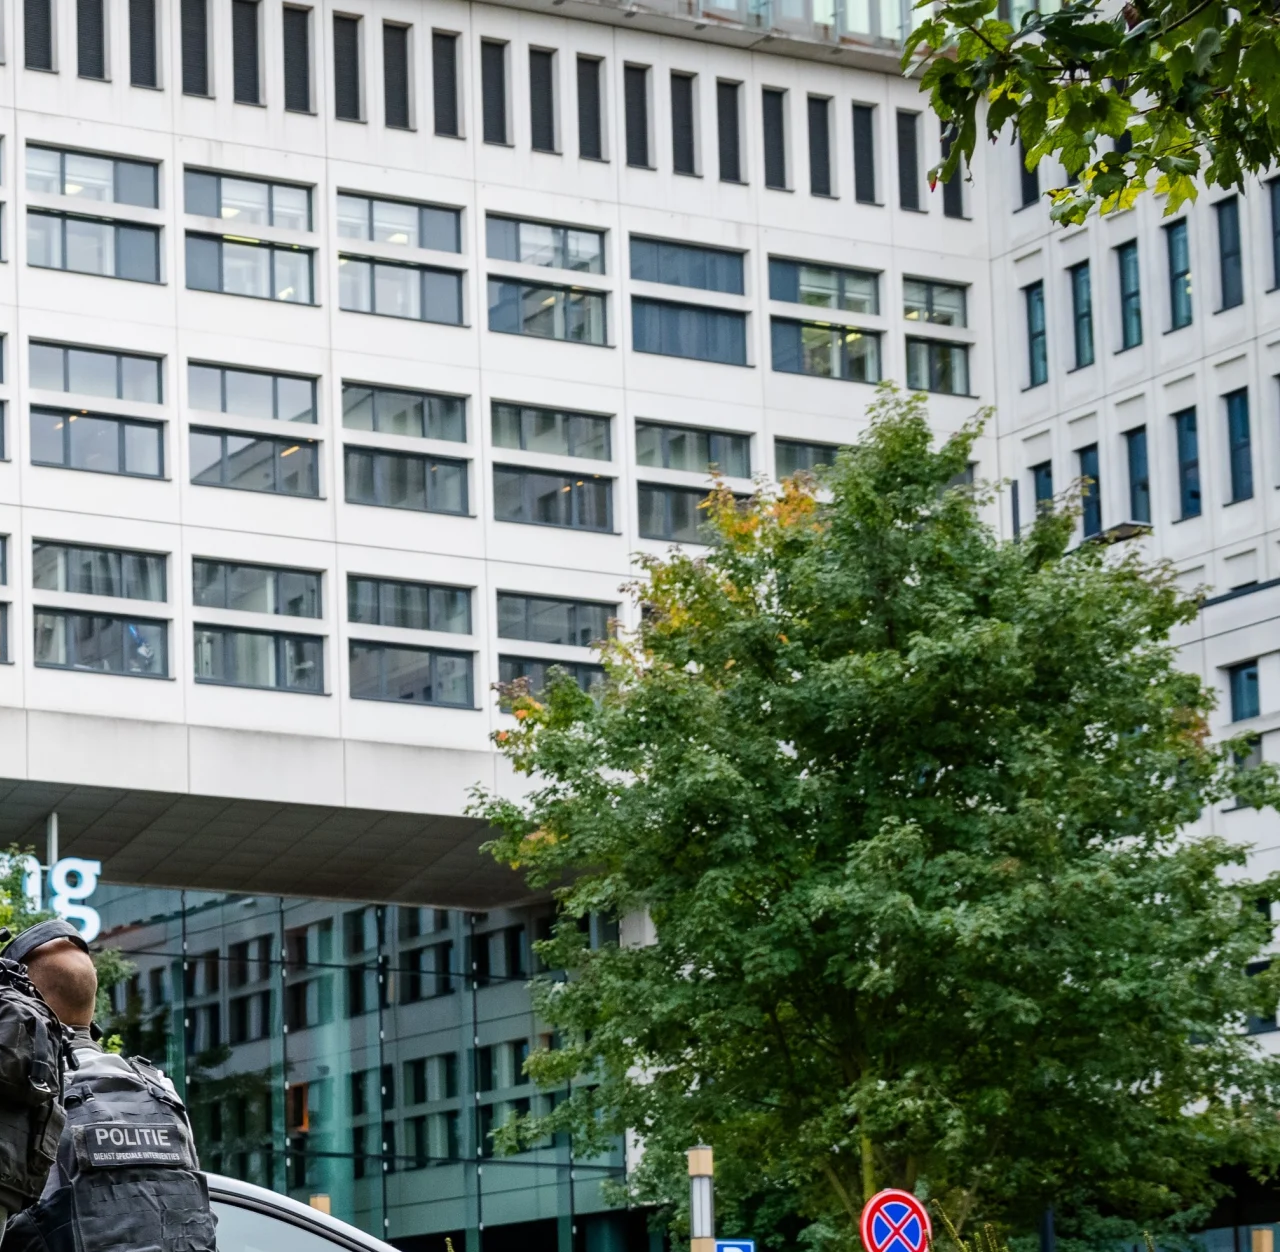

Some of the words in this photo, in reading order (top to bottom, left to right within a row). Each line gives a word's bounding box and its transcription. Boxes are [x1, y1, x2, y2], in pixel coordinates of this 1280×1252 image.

[95, 1128, 171, 1146] POLITIE
[93, 1152, 115, 1160] DIENST
[116, 1151, 142, 1160] SPECIALE
